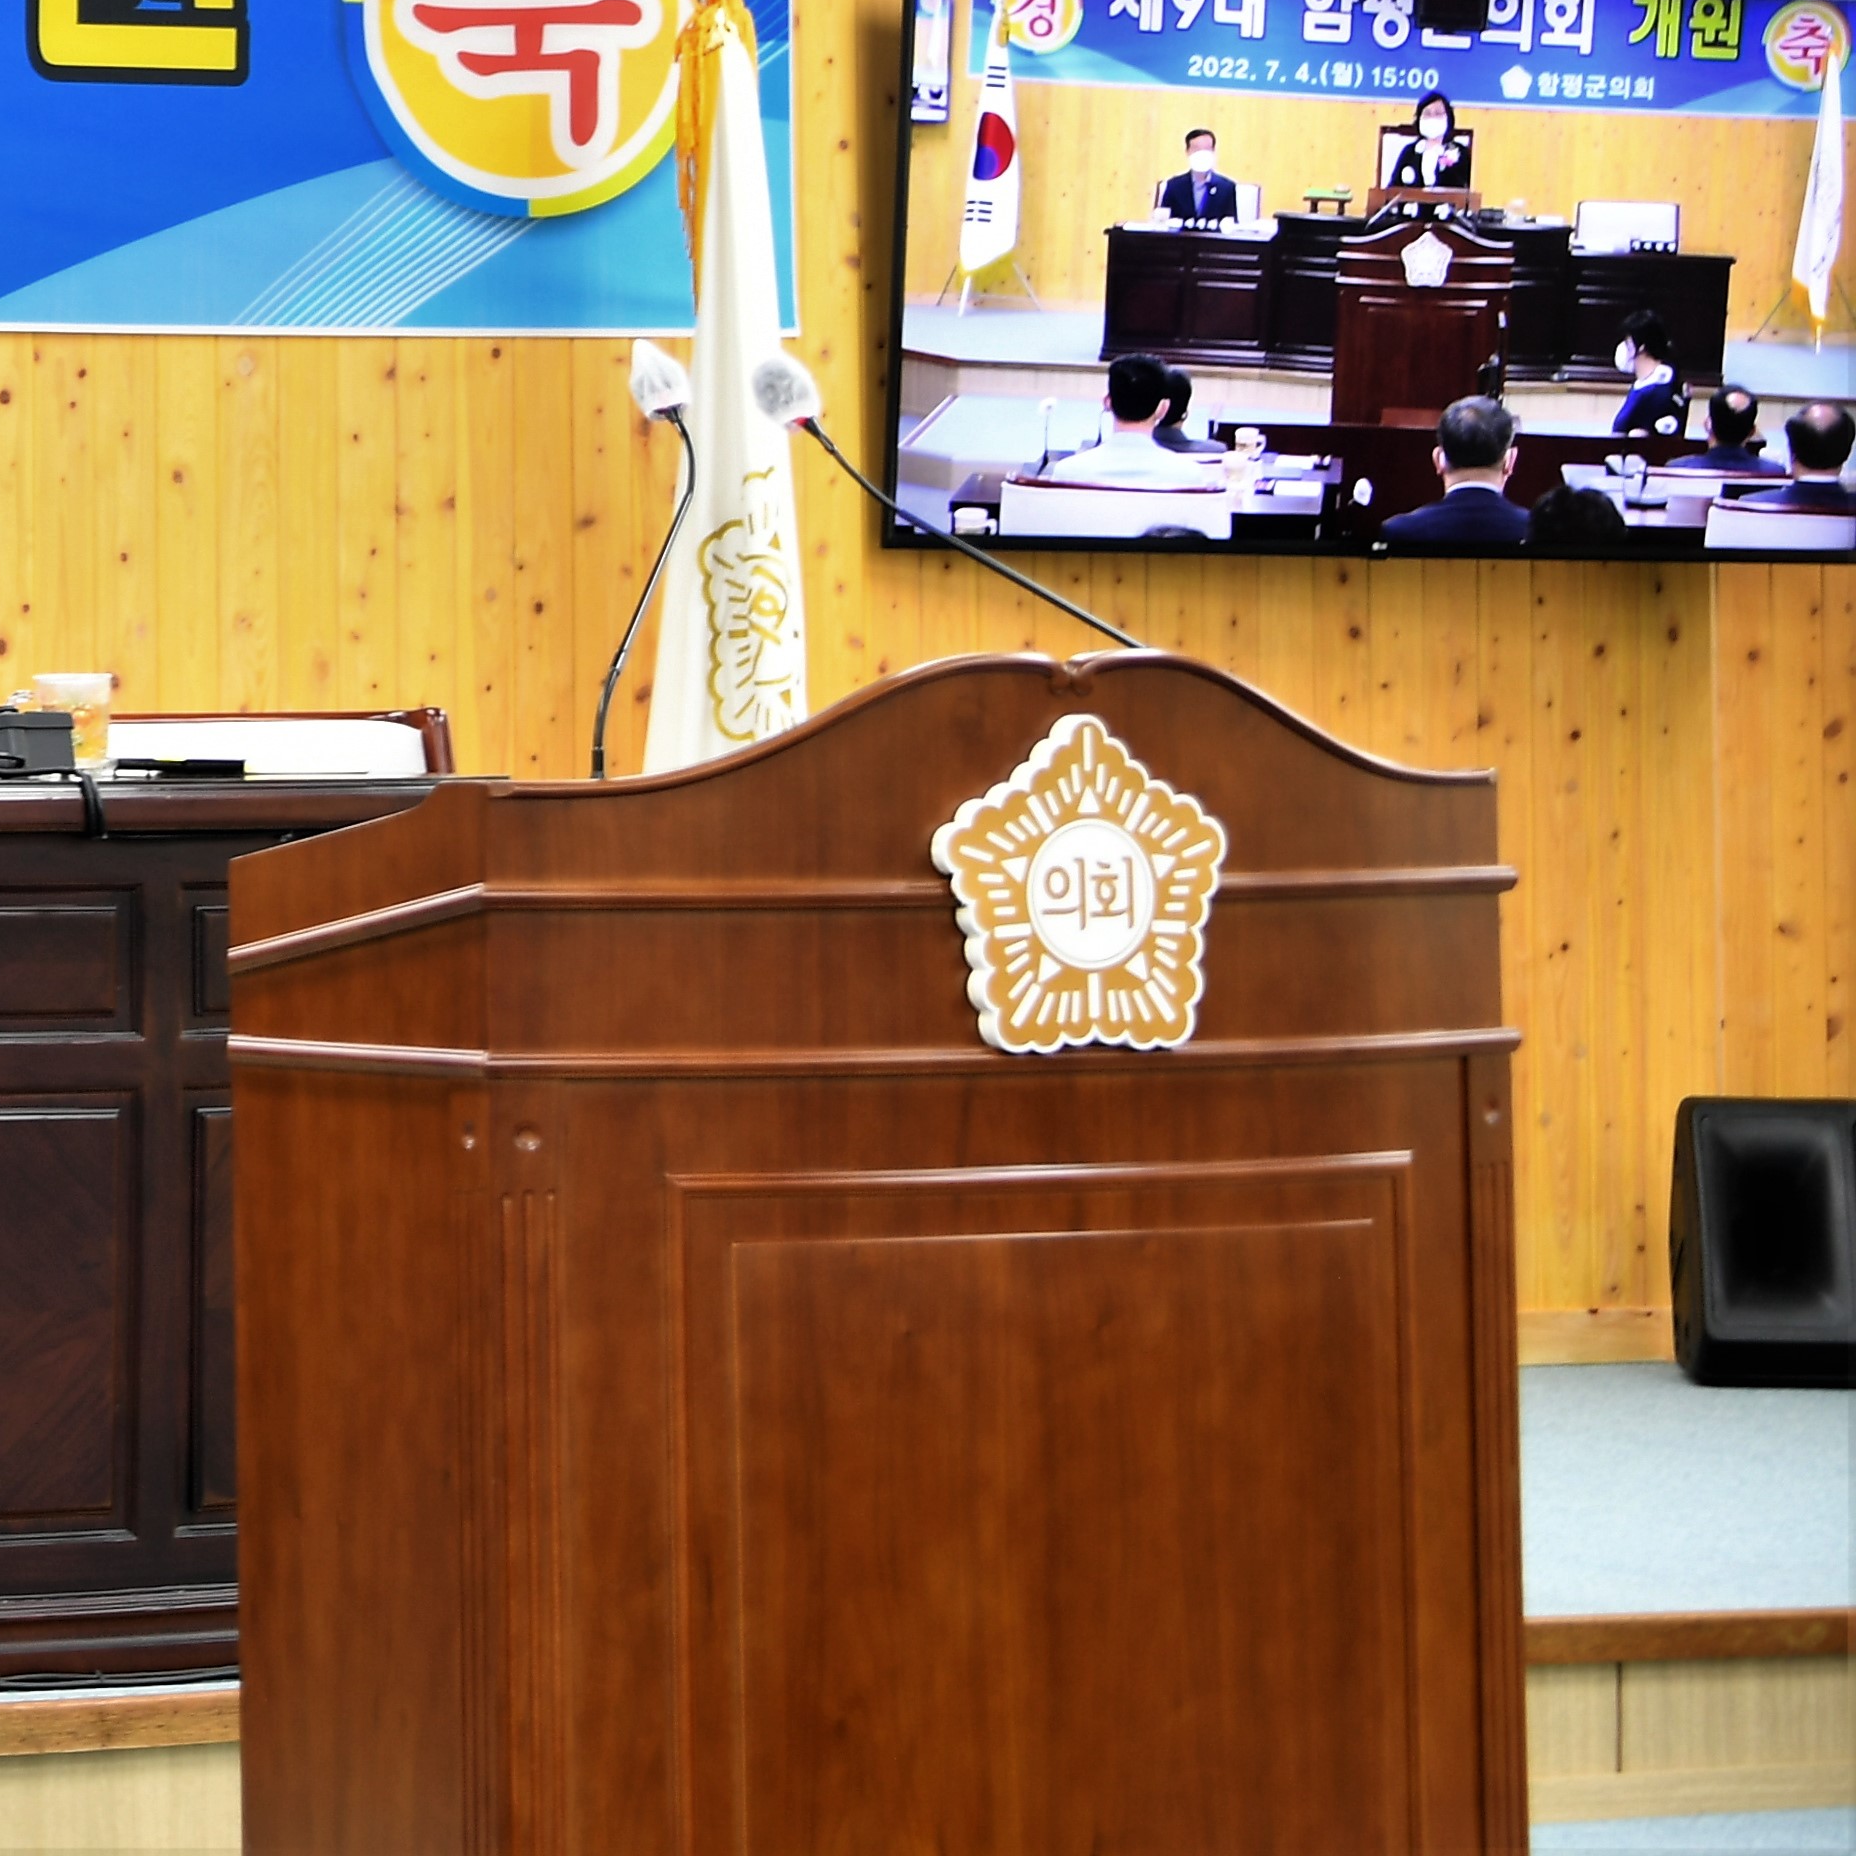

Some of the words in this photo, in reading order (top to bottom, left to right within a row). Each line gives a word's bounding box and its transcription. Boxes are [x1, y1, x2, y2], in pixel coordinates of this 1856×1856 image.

[1187, 54, 1257, 81] 2022.
[1265, 59, 1287, 84] 7.
[1371, 65, 1439, 90] 15:00
[1779, 17, 1829, 76] 축
[1041, 855, 1135, 930] 의회
